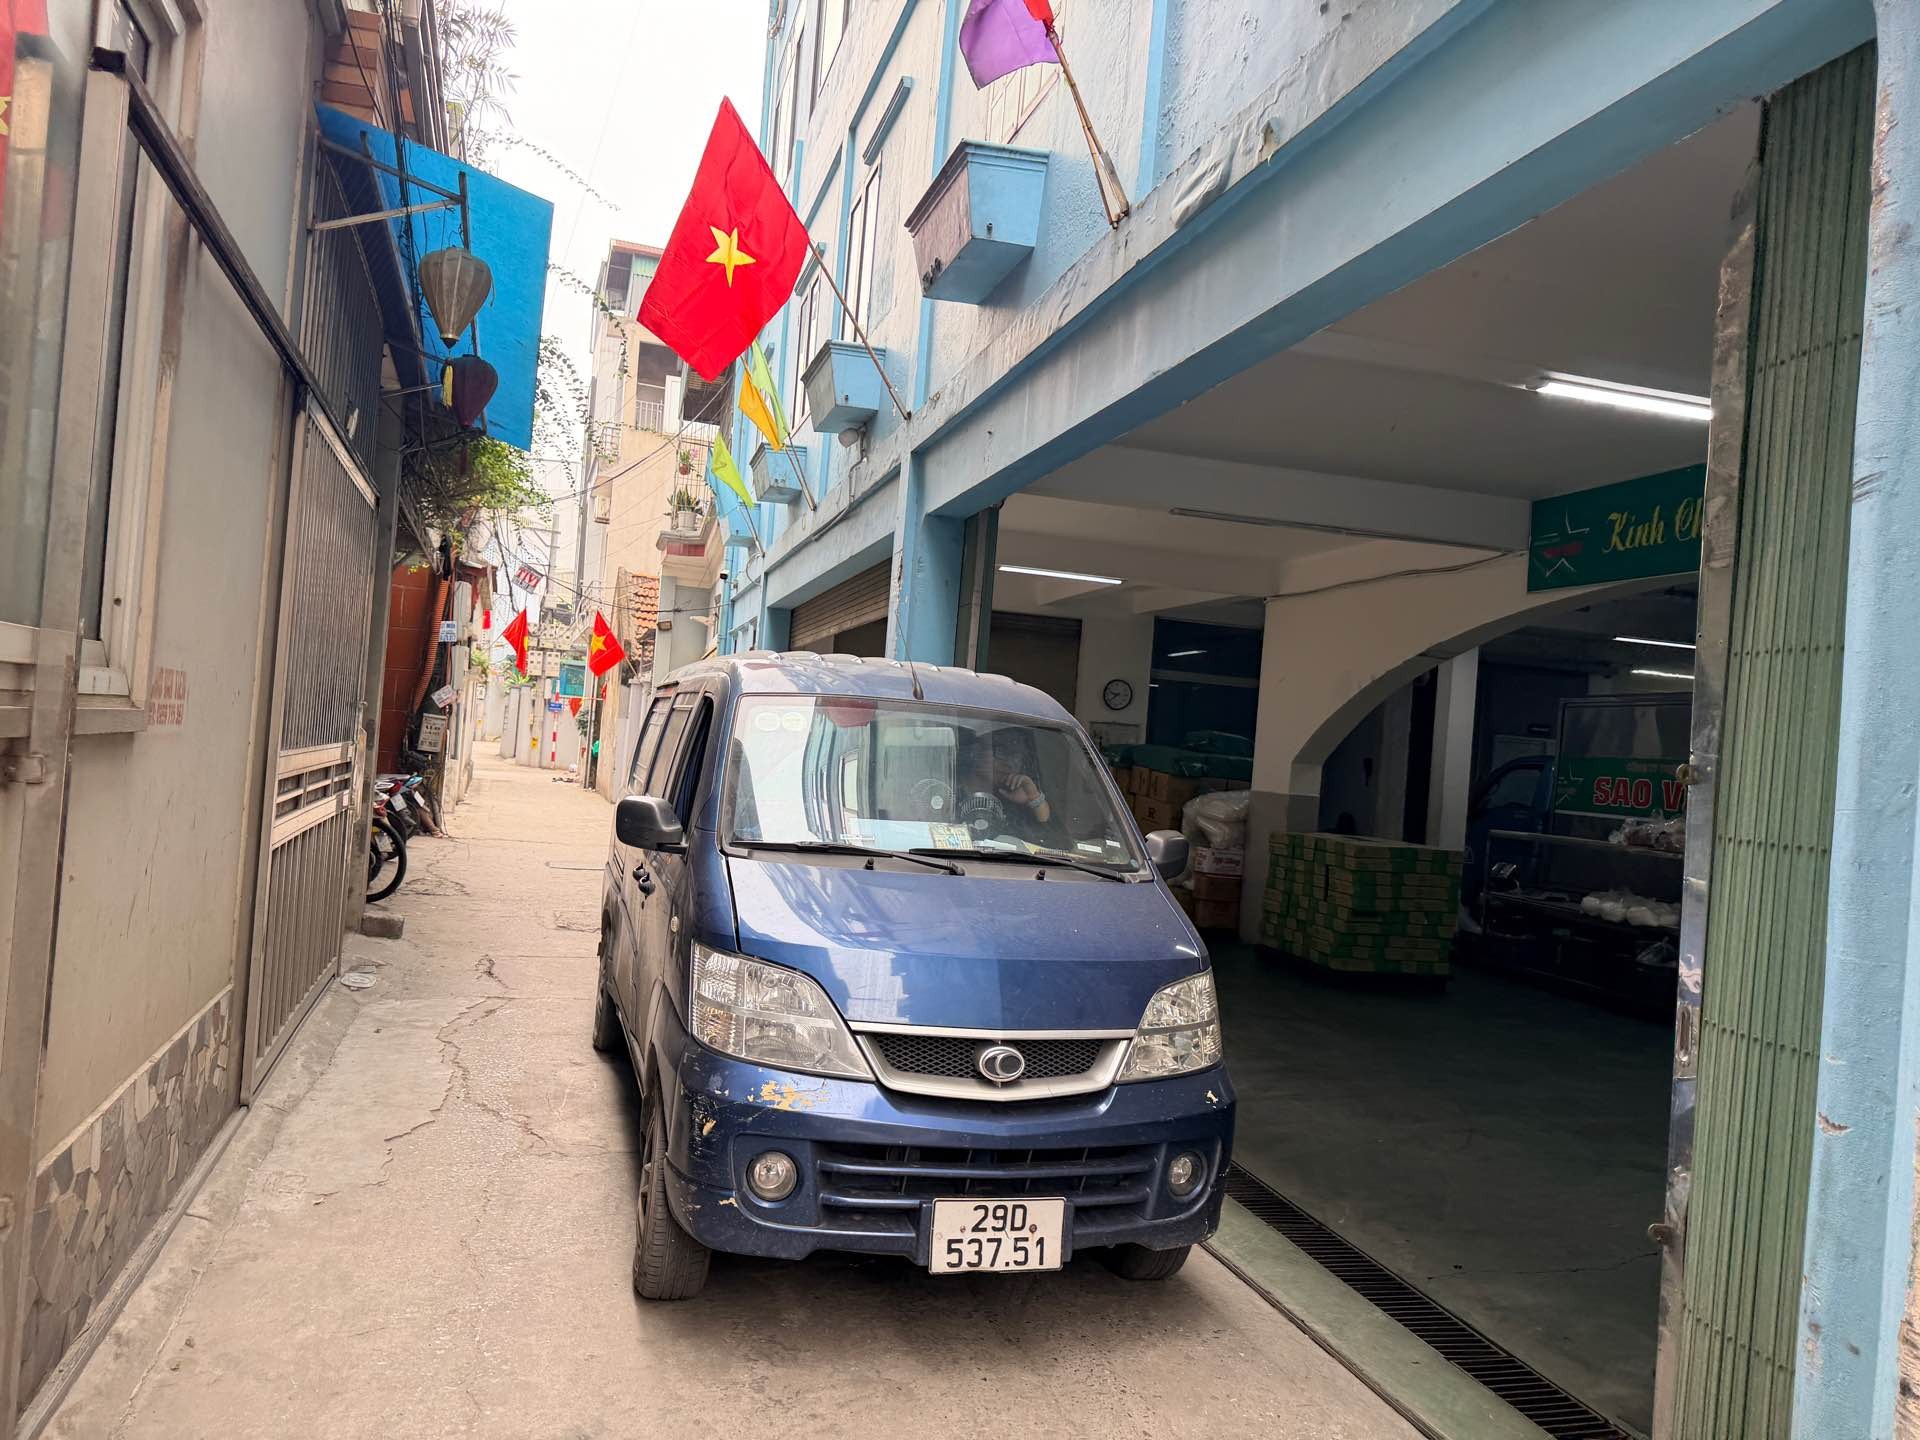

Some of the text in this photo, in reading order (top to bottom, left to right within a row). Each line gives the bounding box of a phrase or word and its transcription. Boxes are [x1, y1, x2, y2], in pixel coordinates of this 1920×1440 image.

[1600, 504, 1665, 554] Kinh
[1593, 776, 1687, 812] SAO V
[971, 1204, 1028, 1233] 29D
[946, 1236, 1045, 1268] 537.51
